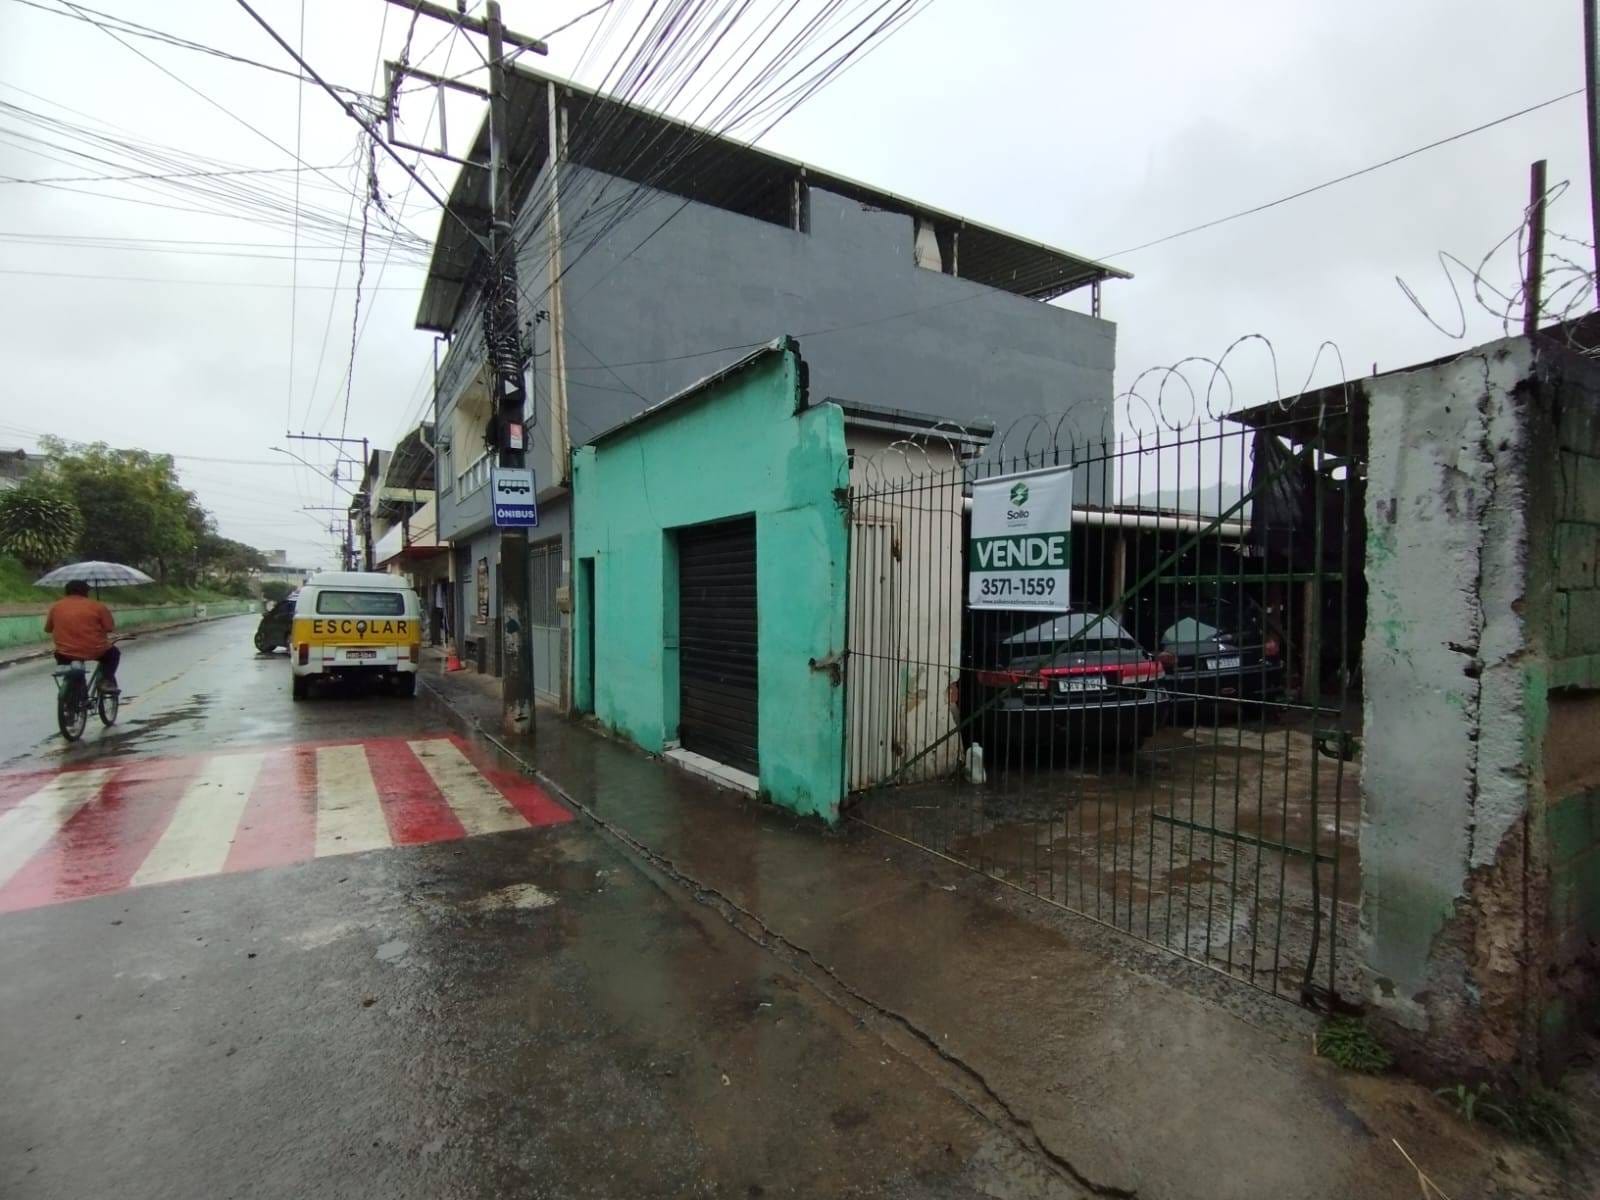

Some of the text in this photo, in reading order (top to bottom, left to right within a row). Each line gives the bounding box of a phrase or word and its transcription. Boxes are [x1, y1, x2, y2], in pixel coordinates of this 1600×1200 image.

[497, 508, 535, 519] ÔNIBUS
[976, 535, 1065, 568] VENDE
[981, 577, 1056, 596] 3571-1559
[313, 620, 408, 639] ESCOLAR
